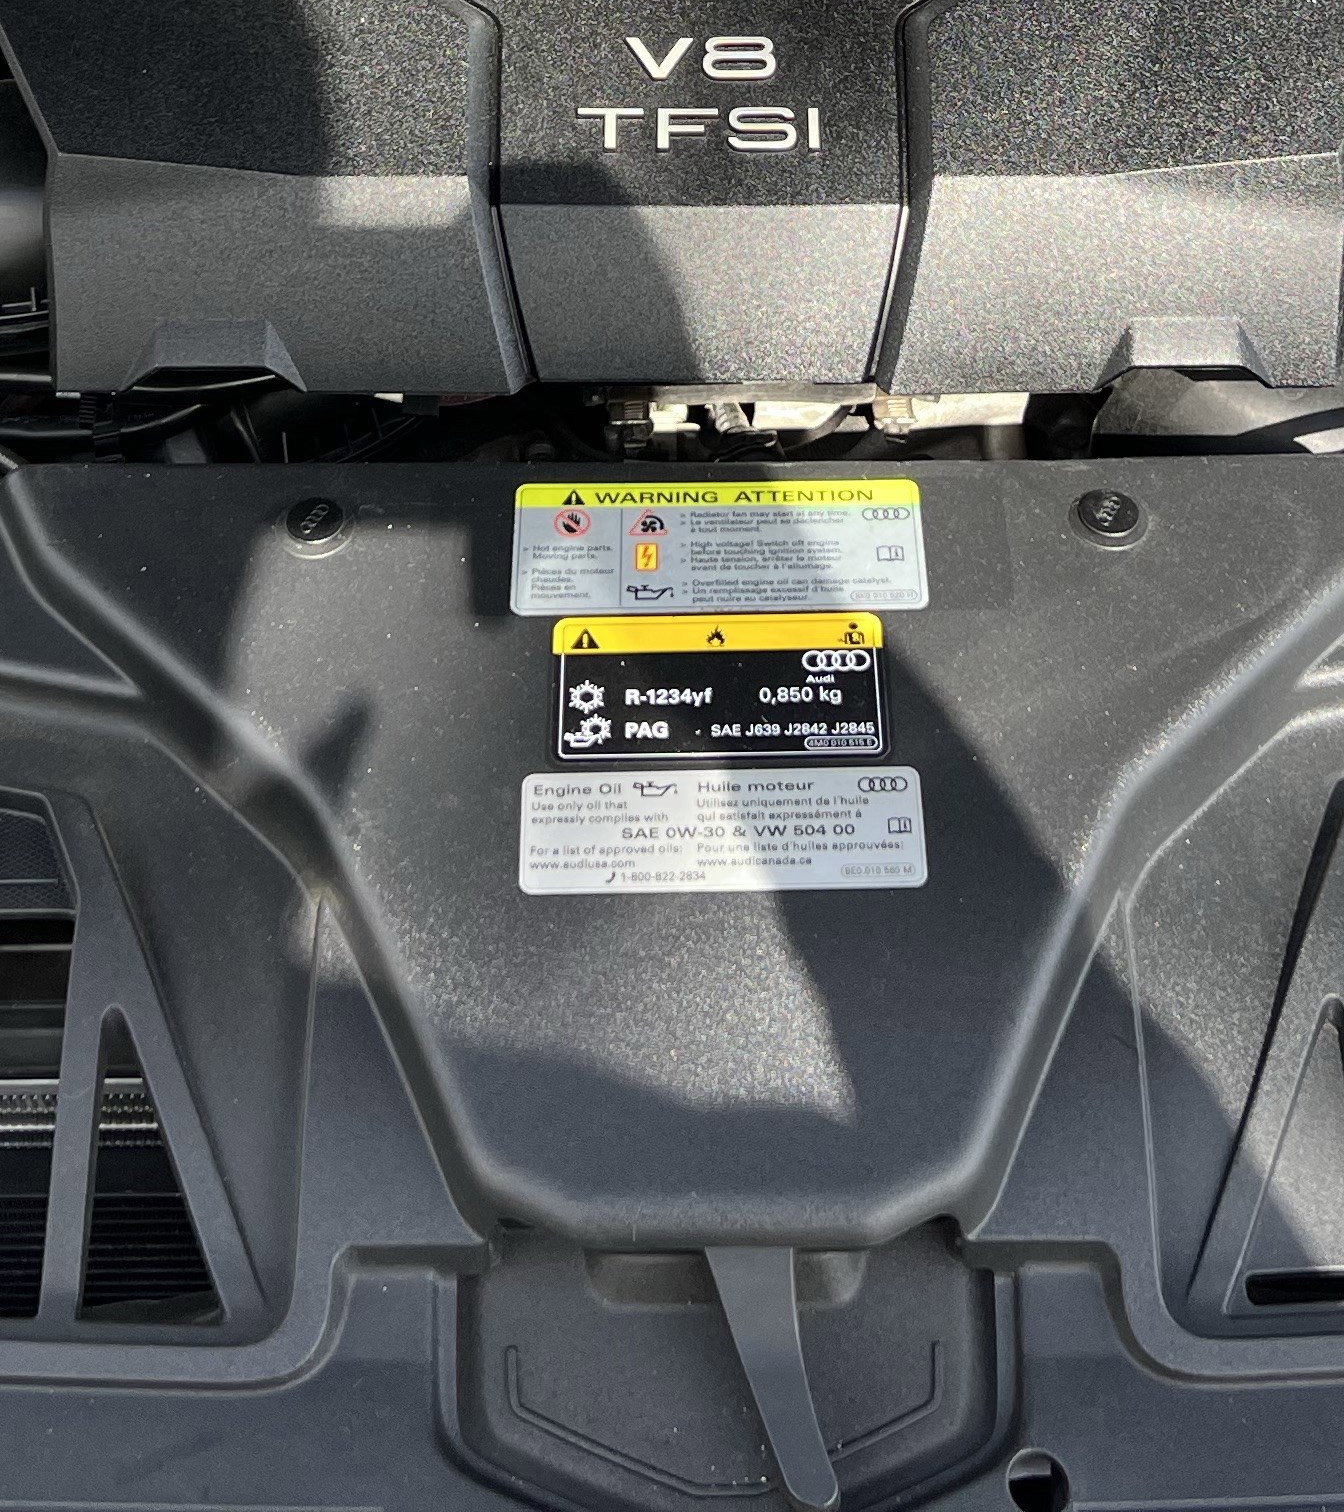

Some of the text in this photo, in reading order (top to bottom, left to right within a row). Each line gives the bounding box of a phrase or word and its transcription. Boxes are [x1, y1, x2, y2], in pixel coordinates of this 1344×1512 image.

[623, 35, 777, 82] V8
[576, 106, 823, 154] TFSI
[594, 489, 875, 504] WARNING ATTENTION
[750, 511, 770, 519] may
[808, 510, 824, 518] any
[757, 518, 777, 526] peut
[552, 545, 585, 553] engine
[690, 540, 713, 548] High
[757, 539, 789, 547] Switch
[807, 539, 840, 547] engine
[532, 552, 569, 560] Moving
[691, 547, 721, 555] before
[724, 547, 766, 556] touching
[690, 555, 718, 563] Haute
[719, 563, 732, 571] de
[741, 579, 774, 587] engine
[810, 578, 850, 586] damage
[692, 595, 714, 603] peut
[805, 674, 835, 684] Audi
[624, 685, 843, 707] R-1234yf 0,850 kg
[624, 721, 875, 740] PAG SAE J639 J2842 J2845
[533, 782, 622, 798] Engine Oil
[697, 780, 815, 793] Huile moteur
[531, 800, 628, 812] Use only oil that
[696, 796, 739, 808] Utilisez
[741, 796, 813, 809] uniquement
[816, 795, 830, 806] de
[531, 812, 669, 825] expressly complies with
[697, 811, 716, 823] qui
[719, 810, 765, 821] satisfait
[768, 809, 853, 821] expressément
[621, 823, 855, 839] SAE 0W-30 & VW 504 00
[530, 845, 549, 856] For
[552, 847, 559, 855] a
[563, 845, 581, 855] list
[583, 844, 596, 855] of
[598, 844, 655, 857] approved
[697, 842, 725, 853] Pour
[728, 843, 750, 852] une
[753, 840, 778, 851] liste
[530, 859, 636, 870] www.audiusa.com
[697, 855, 812, 867] www.audicanada.ca
[620, 870, 706, 883] 1-800-822-2834
